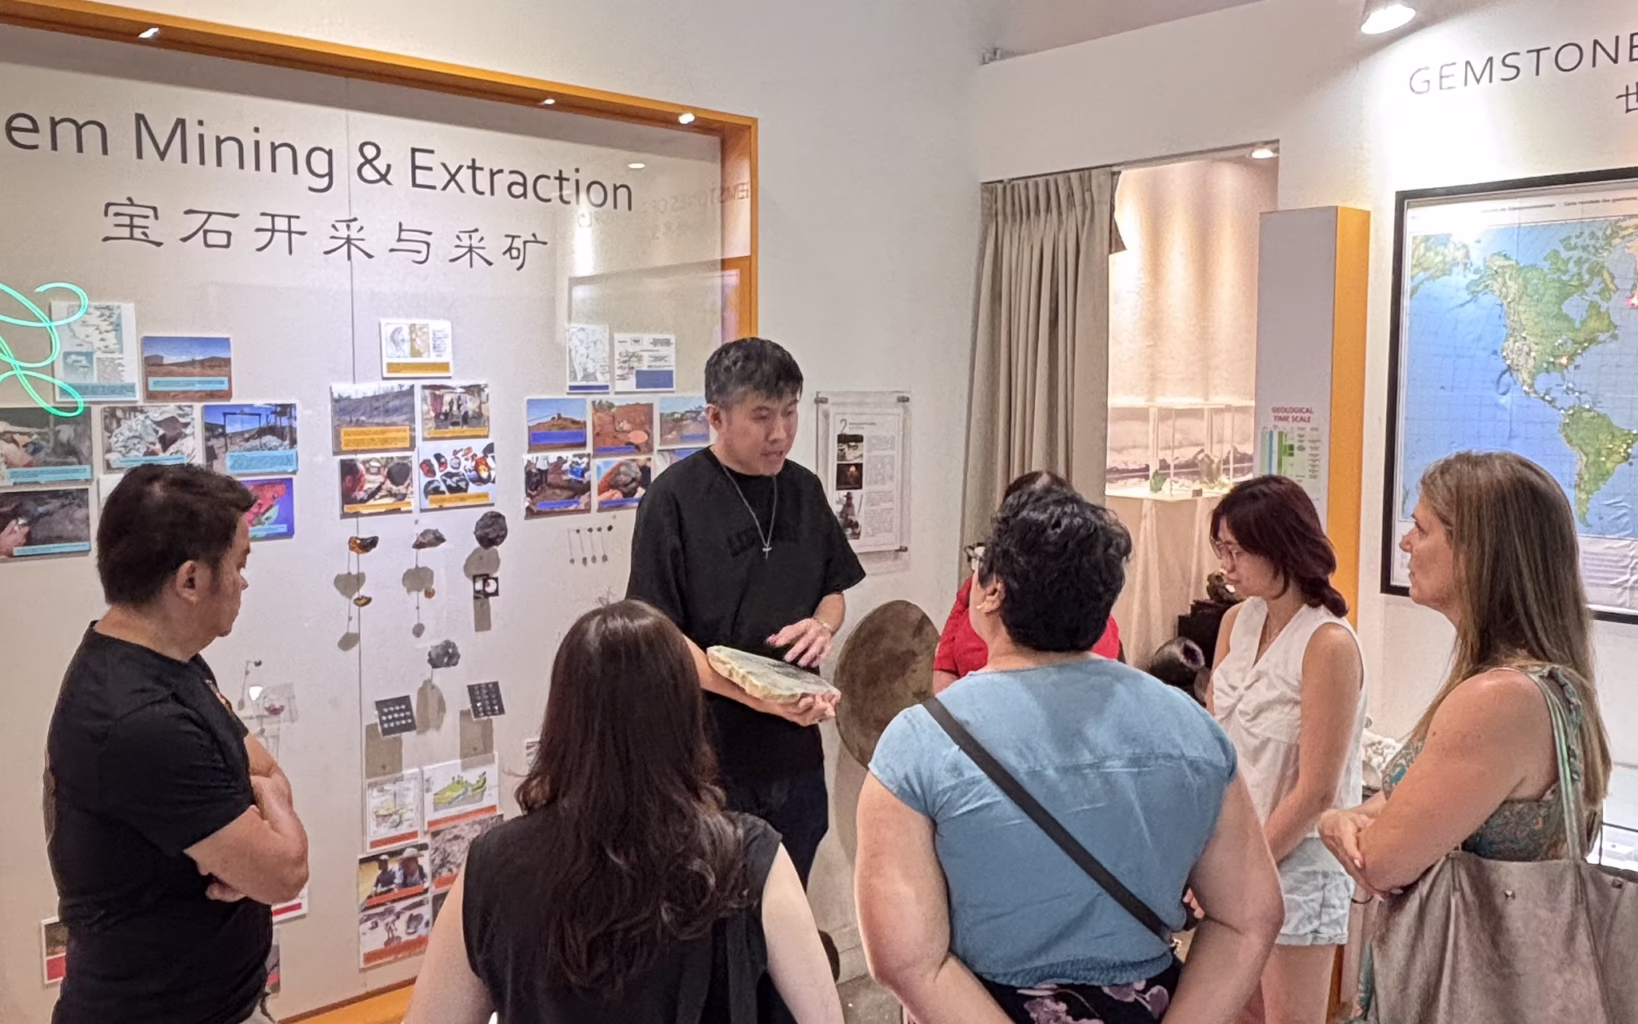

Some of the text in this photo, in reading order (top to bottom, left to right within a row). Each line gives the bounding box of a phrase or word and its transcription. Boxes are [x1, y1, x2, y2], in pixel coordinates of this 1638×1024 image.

[4, 112, 634, 212] em Mining & Extraction
[102, 197, 549, 272] 宝石开采与采矿
[1271, 406, 1314, 415] GEOLOGICAL
[1273, 415, 1311, 424] TIME SCALE
